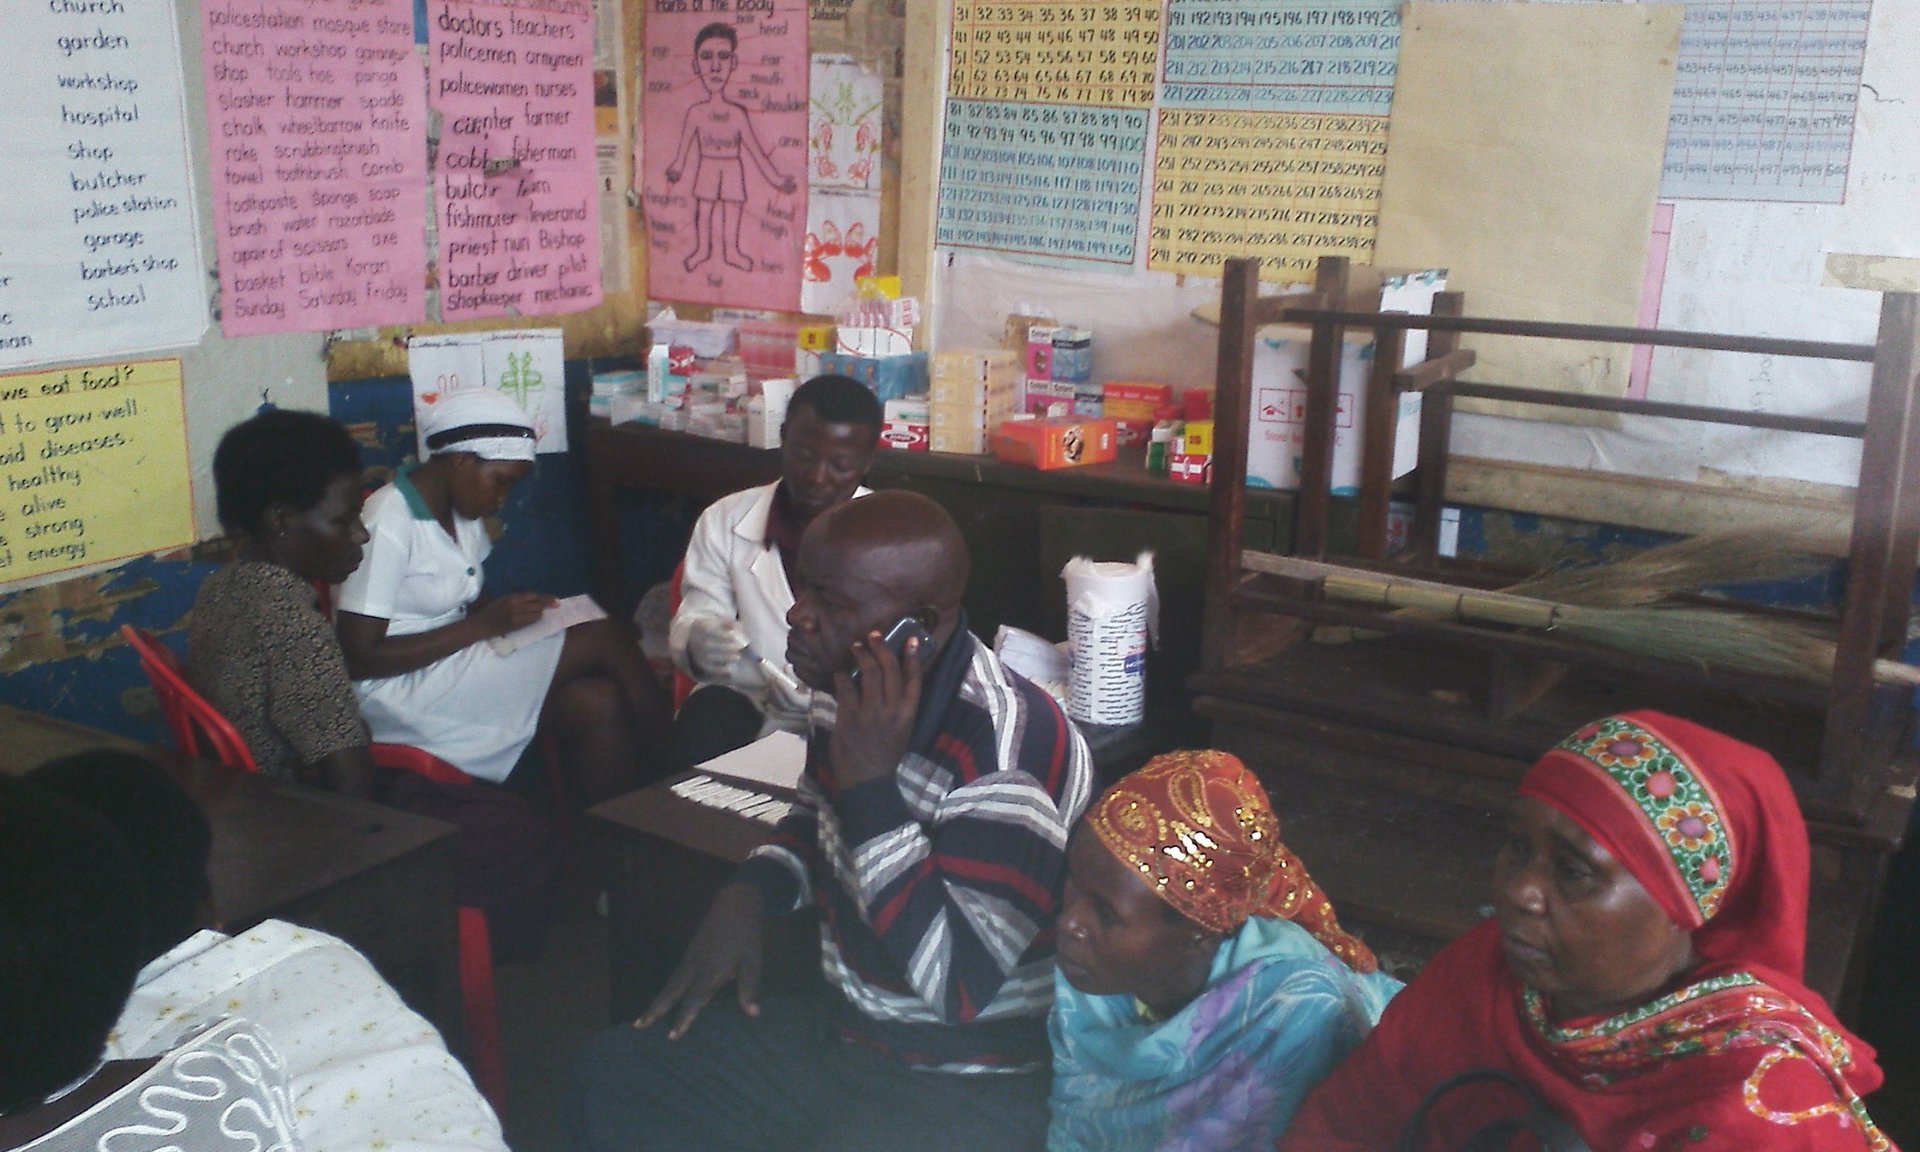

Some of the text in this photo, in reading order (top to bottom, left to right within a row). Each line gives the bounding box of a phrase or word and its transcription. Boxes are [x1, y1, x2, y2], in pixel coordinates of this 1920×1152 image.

[438, 4, 575, 39] doctors teachers
[956, 7, 1159, 22] 31 32 33 34 35 36 37 38 39 40
[1169, 11, 1378, 26] 191 192 193 194 195 196 197 198 199
[313, 17, 370, 38] mosque
[377, 15, 410, 35] store
[760, 20, 788, 35] head
[955, 29, 1159, 45] 41 42 43 44 45 46 47 48 49 50
[58, 26, 128, 56] garden
[212, 33, 264, 56] church
[277, 40, 347, 58] workshop
[440, 36, 583, 71] policemen armymen
[57, 71, 138, 93] workshop
[267, 61, 302, 81] tools
[310, 63, 334, 83] hoe
[355, 67, 397, 87] panga
[440, 71, 577, 98] policewomen nurses
[286, 86, 344, 108] hammer
[360, 88, 404, 110] spade
[62, 102, 139, 127] hospital
[222, 111, 410, 137] chalk wheelbarrow knife
[524, 101, 570, 124] farmer
[948, 123, 1143, 152] 91 92 93 94 95 96 97 98 99 100
[226, 144, 257, 161] rake
[225, 163, 263, 185] towel
[276, 163, 347, 181] toothbrush
[1158, 157, 1366, 176] 251 252 253 254 255 256 257 258 259
[70, 169, 146, 191] butcher
[74, 194, 177, 224] police station
[230, 219, 267, 237] brush
[284, 215, 318, 232] water
[83, 231, 144, 253] garage
[372, 233, 398, 247] axe
[449, 228, 585, 262] priest nun Bishop
[142, 254, 178, 271] shop
[449, 253, 587, 287] barber driver pilot
[234, 270, 284, 292] basket
[88, 283, 146, 311] school
[234, 280, 407, 319] Sunday Saturday Friday
[535, 283, 592, 303] mechanic
[1, 365, 134, 401] we eat food?
[16, 413, 36, 432] to
[45, 410, 92, 434] grow
[41, 432, 134, 459] diseases.
[9, 466, 81, 491] healthy
[22, 495, 66, 516] alive
[25, 518, 84, 537] strong
